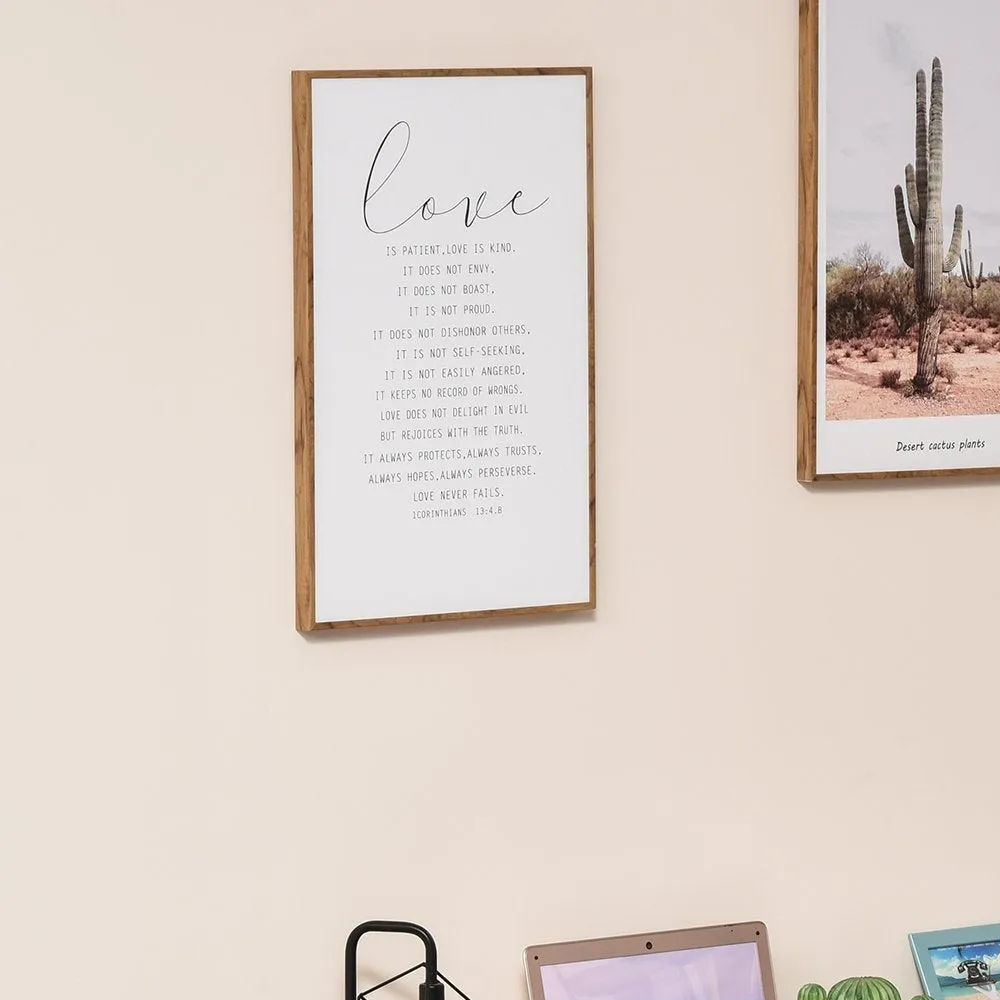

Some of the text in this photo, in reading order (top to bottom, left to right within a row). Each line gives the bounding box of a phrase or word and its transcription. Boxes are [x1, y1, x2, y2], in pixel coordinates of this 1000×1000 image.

[364, 121, 549, 234] love
[386, 245, 399, 257] IS
[474, 243, 485, 254] IS
[403, 265, 414, 277] IT
[418, 264, 441, 276] DOES
[446, 264, 463, 275] NOT
[398, 286, 408, 297] IT
[413, 285, 436, 297] DOES
[441, 284, 457, 295] NOT
[409, 306, 419, 317] IT
[425, 305, 436, 317] IS
[441, 304, 458, 316] NOT
[373, 330, 383, 341] IT
[389, 328, 413, 340] DOES
[418, 327, 435, 340] NOT
[441, 325, 487, 338] DISHONOR
[396, 349, 407, 360] IT
[413, 348, 424, 360] IS
[429, 347, 447, 359] NOT
[385, 370, 396, 381] IT
[402, 369, 413, 381] IS
[418, 368, 435, 380] NOT
[441, 367, 475, 379] EASILY
[375, 390, 385, 401] IT
[390, 388, 417, 400] KEEPS
[421, 387, 432, 399] NO
[436, 386, 468, 398] RECORD
[472, 385, 483, 397] OF
[380, 403, 529, 421] LOVE DOES NOT DELIGHT IN EVIL
[380, 430, 396, 442] BUT
[401, 427, 443, 440] REJOICES
[447, 427, 469, 438] WITH
[473, 425, 488, 437] THE
[896, 438, 986, 452] Desert cactus plants
[364, 453, 374, 465] IT
[379, 451, 413, 463] ALWAYS
[368, 472, 402, 484] ALWAYS
[413, 486, 504, 502] LOVE NEVER FAILS.
